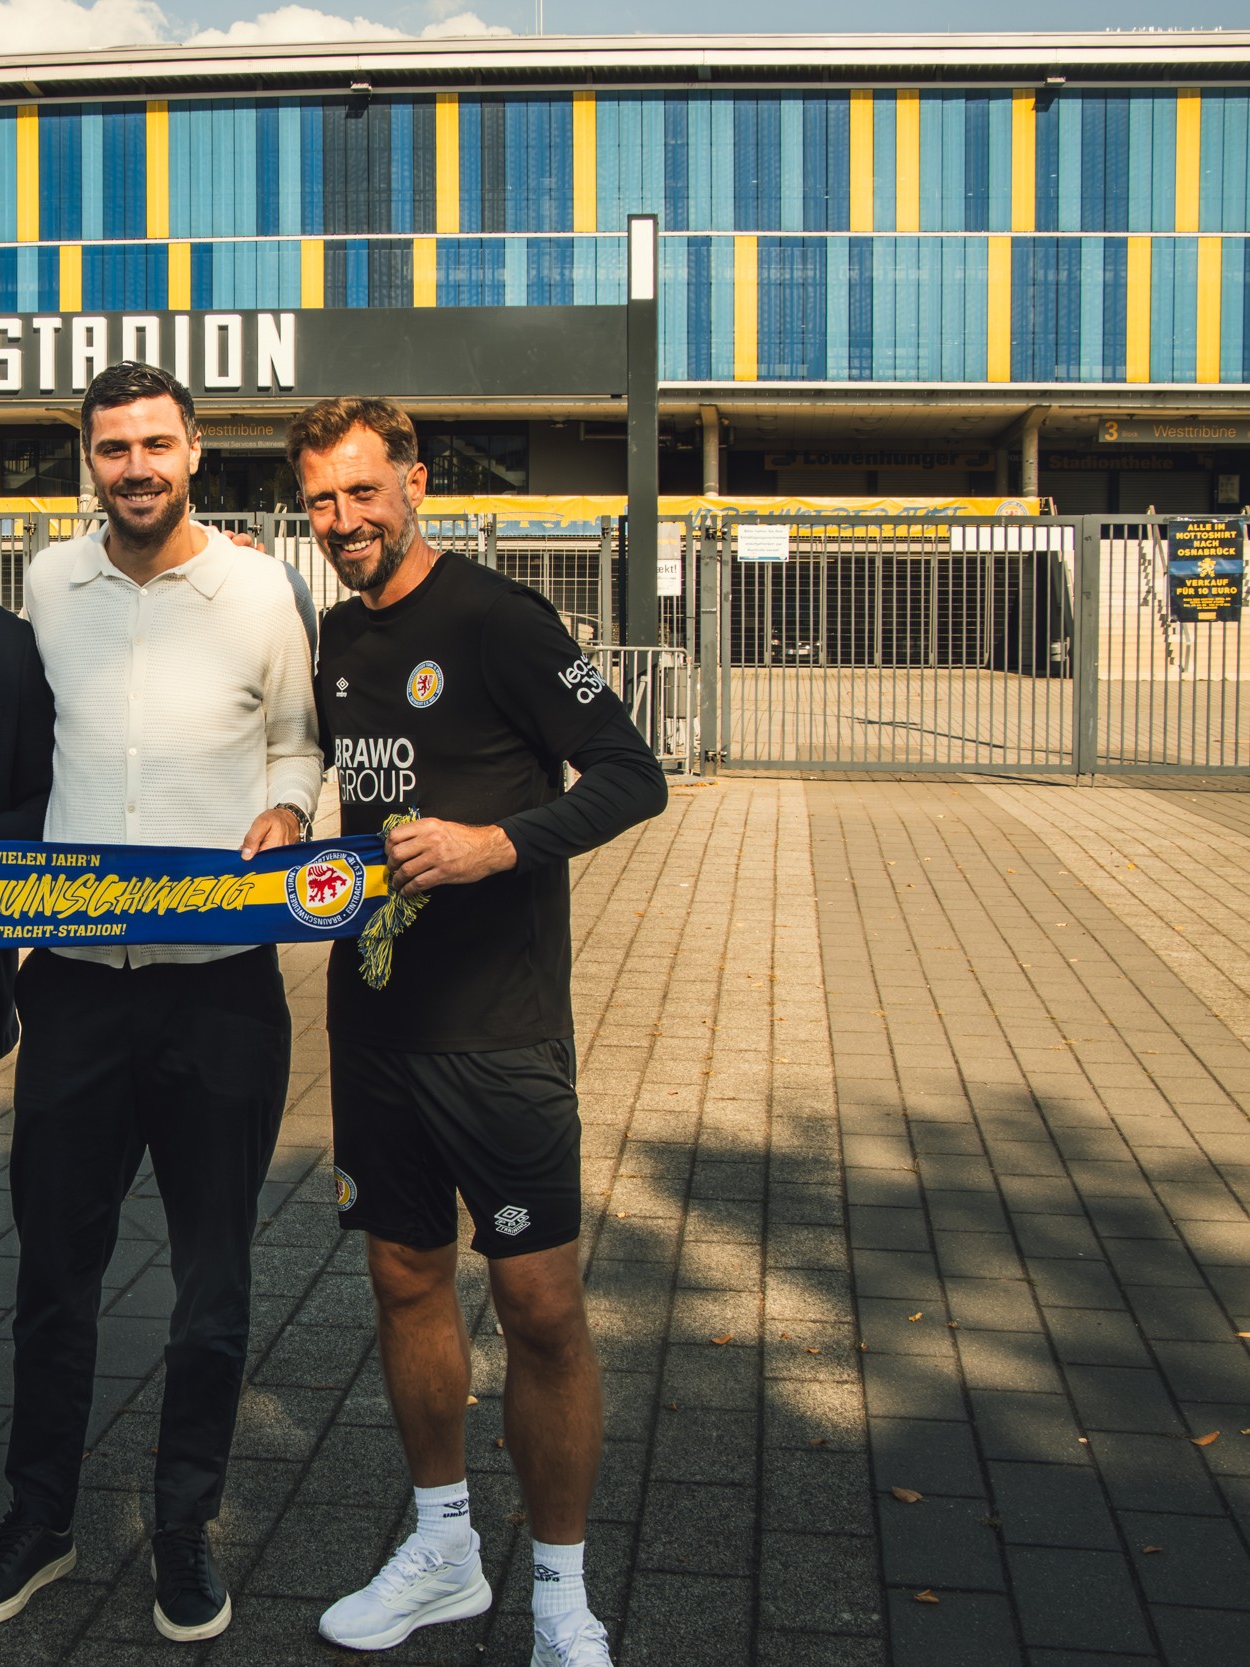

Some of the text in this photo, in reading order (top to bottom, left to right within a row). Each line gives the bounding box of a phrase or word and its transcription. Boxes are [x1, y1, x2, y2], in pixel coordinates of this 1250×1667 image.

[1105, 421, 1118, 441] 3
[1153, 424, 1237, 438] Westtribüne
[1049, 454, 1174, 469] Stadiontheke
[1187, 523, 1212, 531] ALLE
[1175, 531, 1237, 539] MOTTOSHIRT
[1177, 547, 1236, 556] OSNABRÜCK
[1176, 587, 1195, 595] FÜR
[335, 738, 414, 769] BRAWO
[339, 769, 416, 803] GROUP
[51, 853, 100, 867] JAHR'N
[346, 876, 362, 914] EINTRACHT
[289, 893, 342, 925] BRAUNSCHWEIGER
